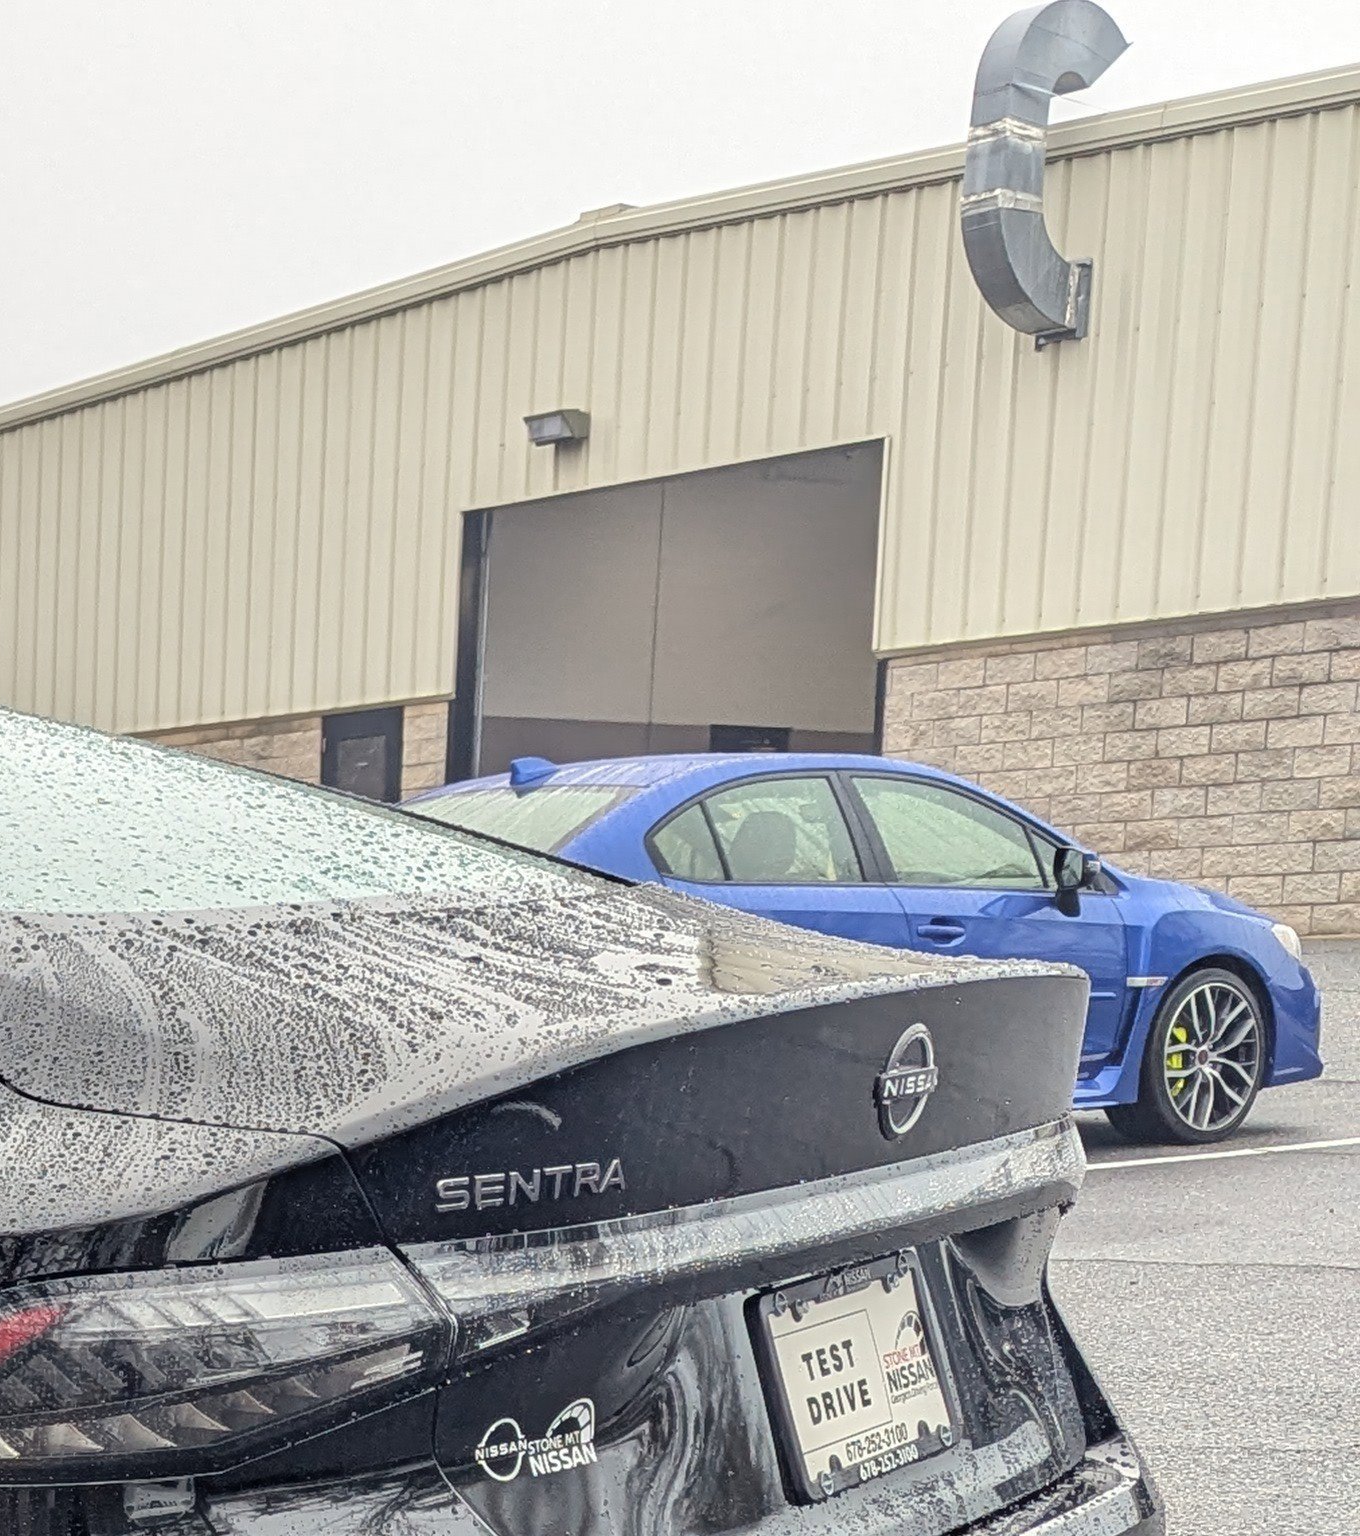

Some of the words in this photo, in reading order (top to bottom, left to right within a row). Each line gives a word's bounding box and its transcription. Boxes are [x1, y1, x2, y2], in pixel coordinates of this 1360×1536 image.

[883, 1073, 938, 1098] NISSA
[435, 1157, 626, 1212] SENTRA
[801, 1339, 855, 1381] TEST
[886, 1357, 936, 1393] NISSAN
[806, 1378, 872, 1426] DRIVE
[475, 1439, 528, 1461] NISSAN
[527, 1433, 563, 1455] STONE
[565, 1430, 581, 1446] MT
[528, 1442, 598, 1477] NISSAN
[845, 1422, 909, 1462] 678-252-3100
[860, 1443, 919, 1481] 678-252-3100
